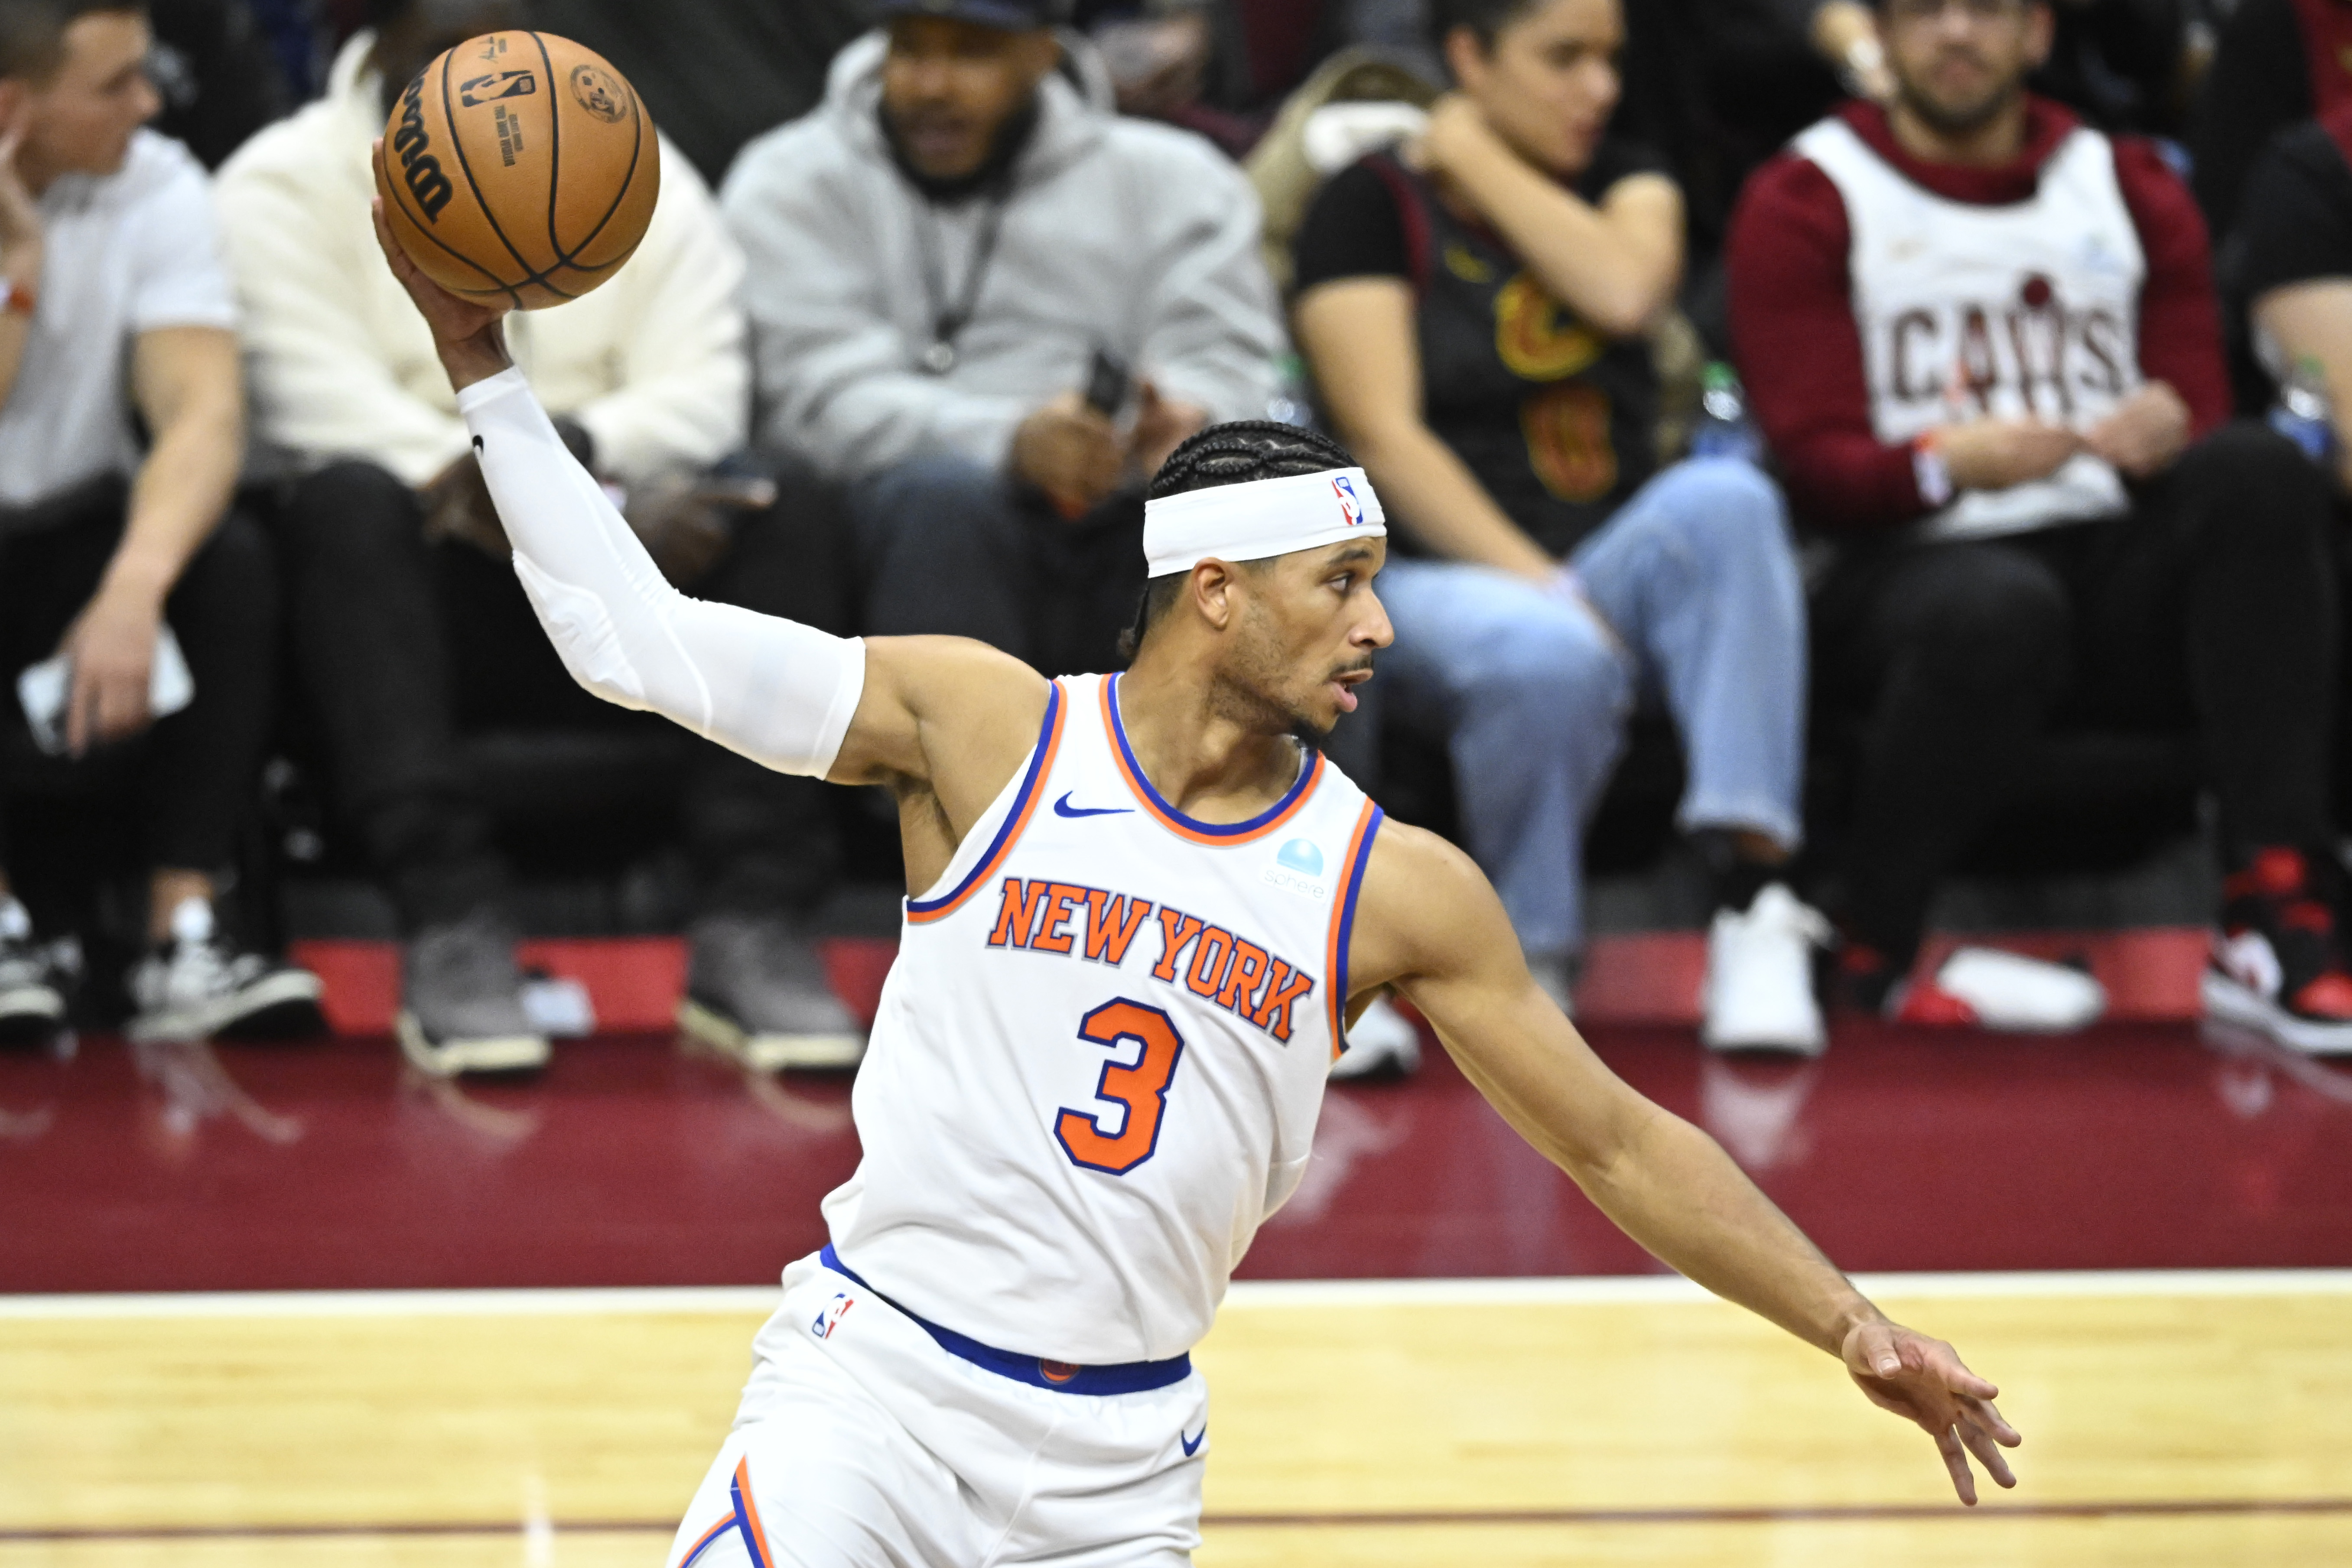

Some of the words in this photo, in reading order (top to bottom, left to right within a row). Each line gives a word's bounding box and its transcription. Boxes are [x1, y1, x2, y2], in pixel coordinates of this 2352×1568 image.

[986, 877, 1155, 968] NEW
[1149, 904, 1316, 1045] YORK
[1264, 869, 1324, 898] sphere
[1054, 996, 1185, 1177] 3
